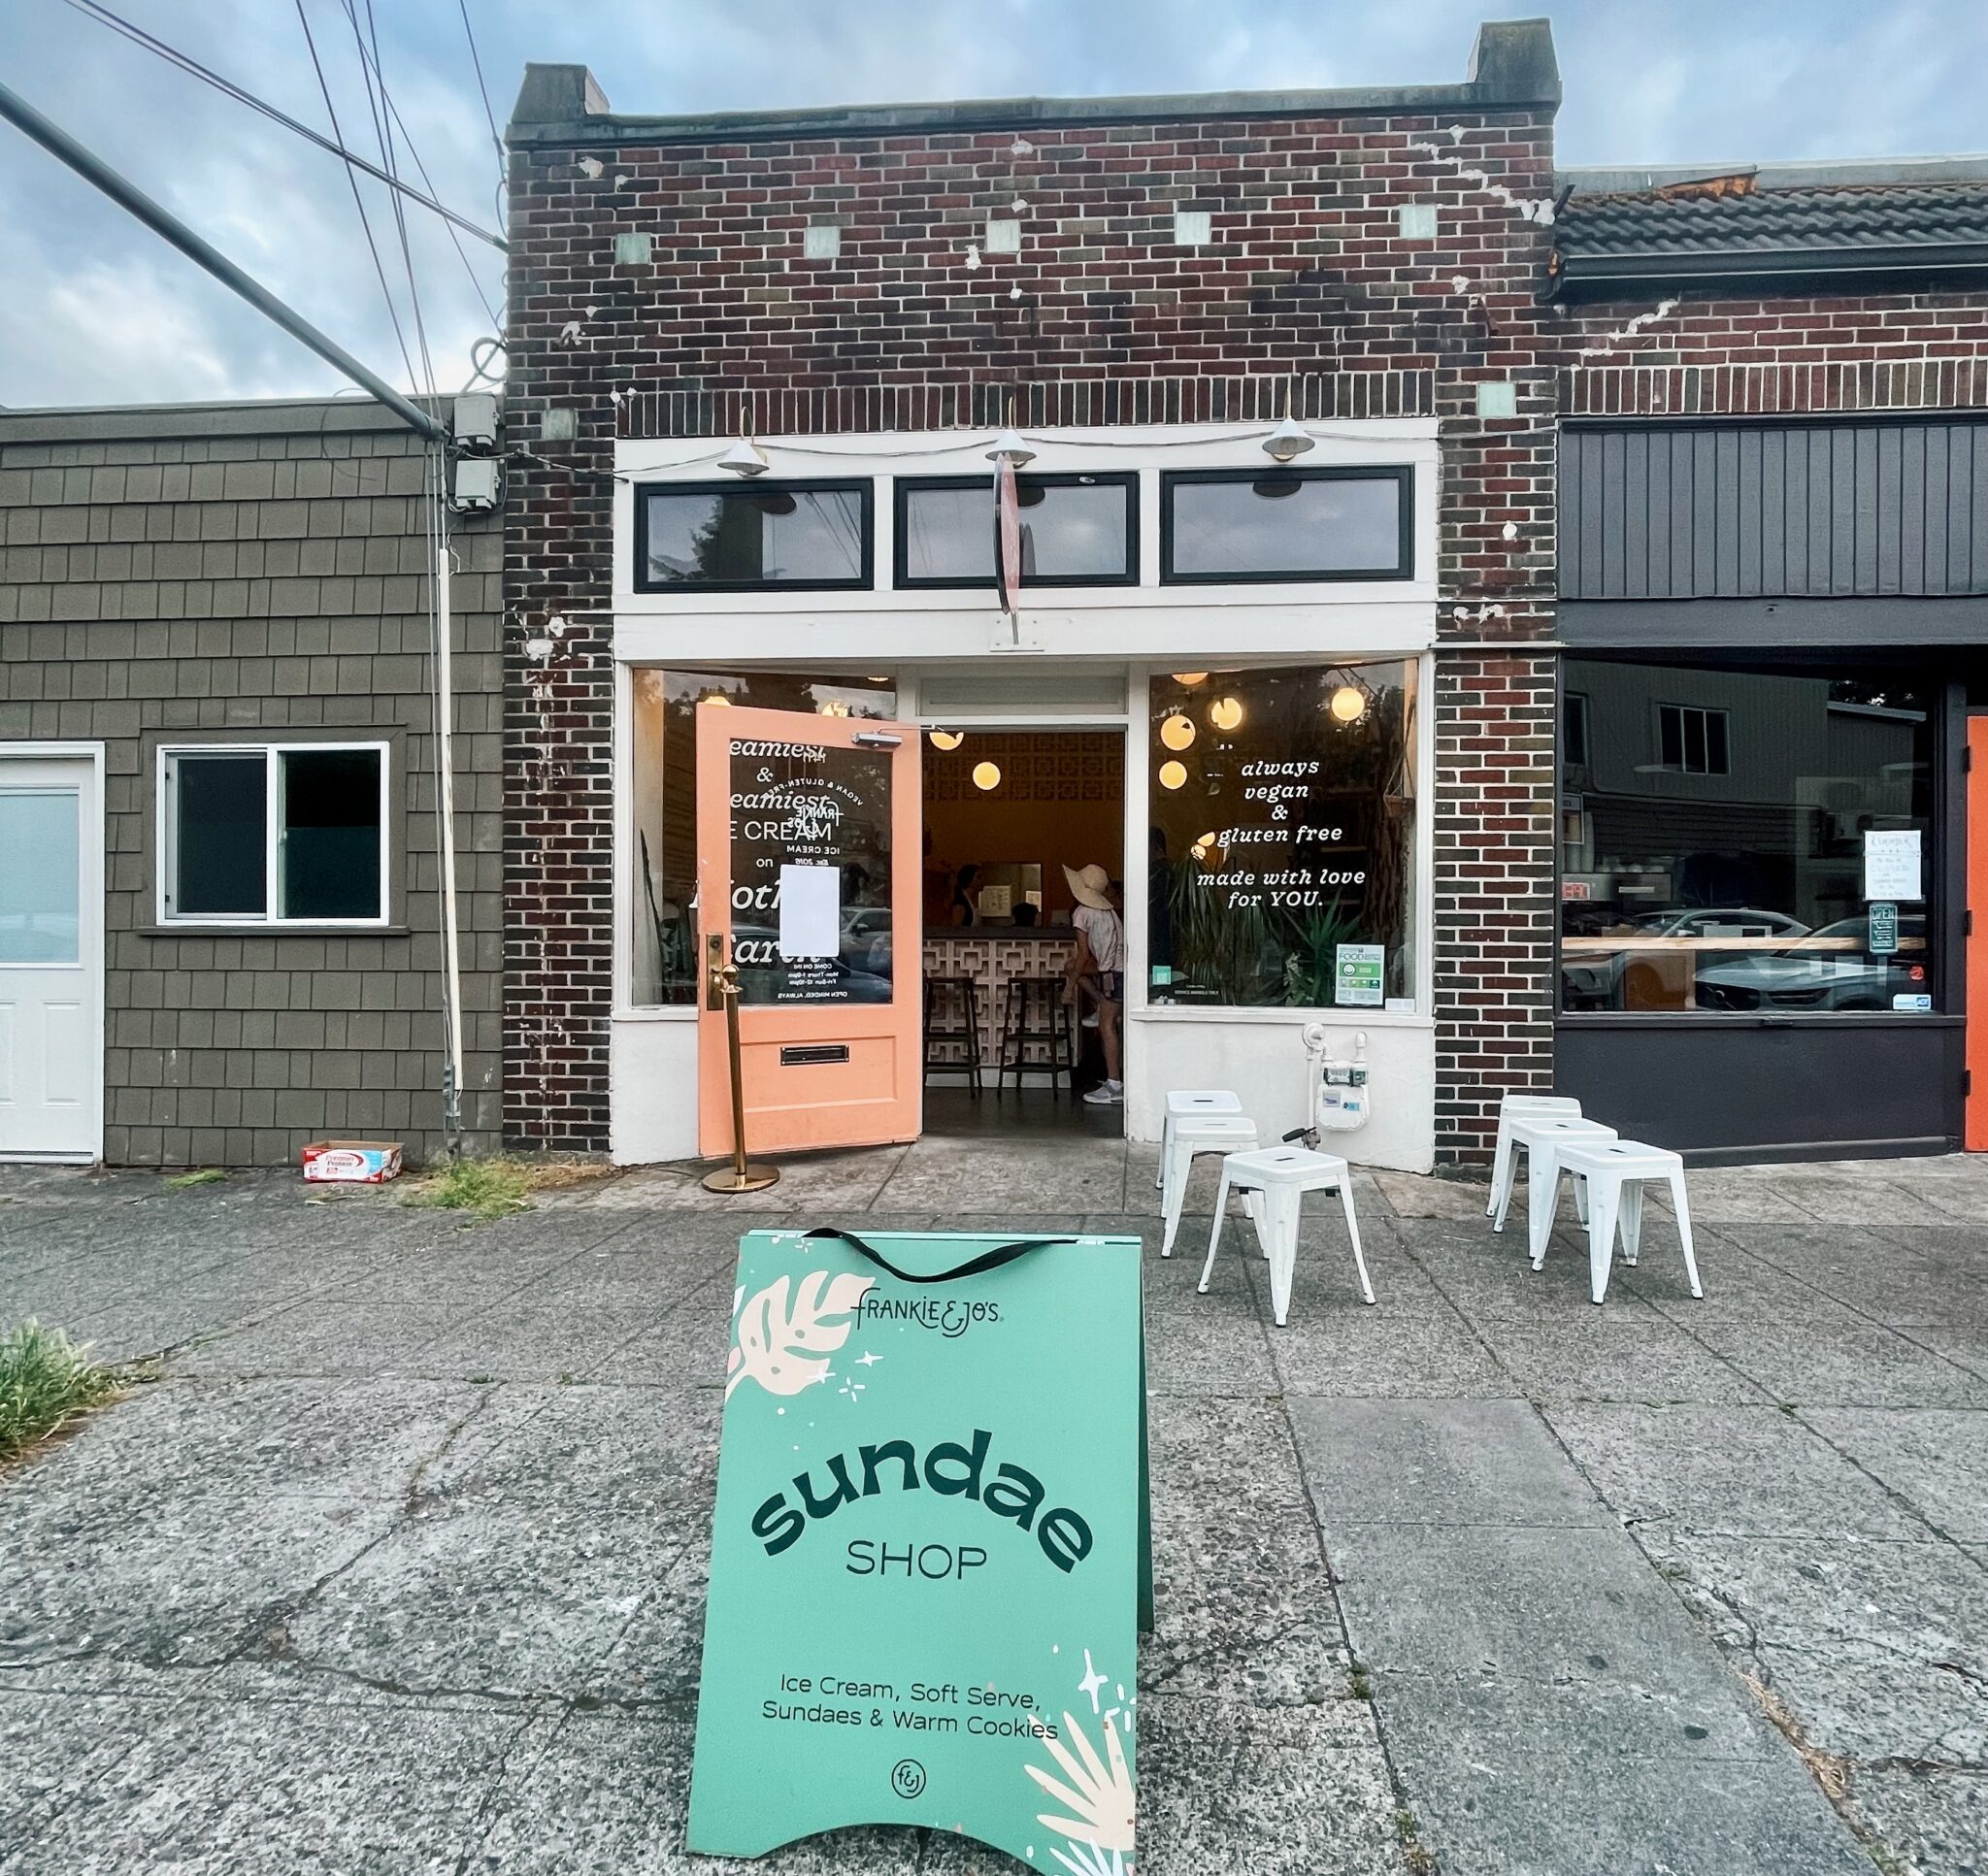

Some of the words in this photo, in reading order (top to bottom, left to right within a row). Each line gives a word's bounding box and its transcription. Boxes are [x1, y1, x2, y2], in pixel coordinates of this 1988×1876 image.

[730, 741, 826, 758] eamiest
[756, 767, 774, 782] &
[1242, 760, 1319, 777] always
[730, 790, 830, 809] eamiest
[1244, 784, 1309, 804] vegan
[1272, 805, 1288, 820] &
[745, 821, 831, 841] CREAM
[1217, 828, 1288, 847] gluten
[1296, 826, 1342, 843] free
[756, 858, 774, 868] on
[1197, 871, 1255, 886] made
[1263, 870, 1311, 885] with
[1319, 870, 1366, 884] love
[1228, 892, 1261, 908] for
[1271, 891, 1323, 906] YOU.
[751, 1429, 1093, 1573] sundae
[846, 1540, 987, 1580] SHOP
[779, 1674, 812, 1694] Ice
[819, 1677, 901, 1702] Cream,
[911, 1683, 958, 1705] Soft
[967, 1687, 1042, 1712] Serve,
[762, 1700, 862, 1726] Sundaes
[870, 1709, 883, 1727] &
[892, 1711, 958, 1732] Warm
[967, 1716, 1058, 1740] Cookies
